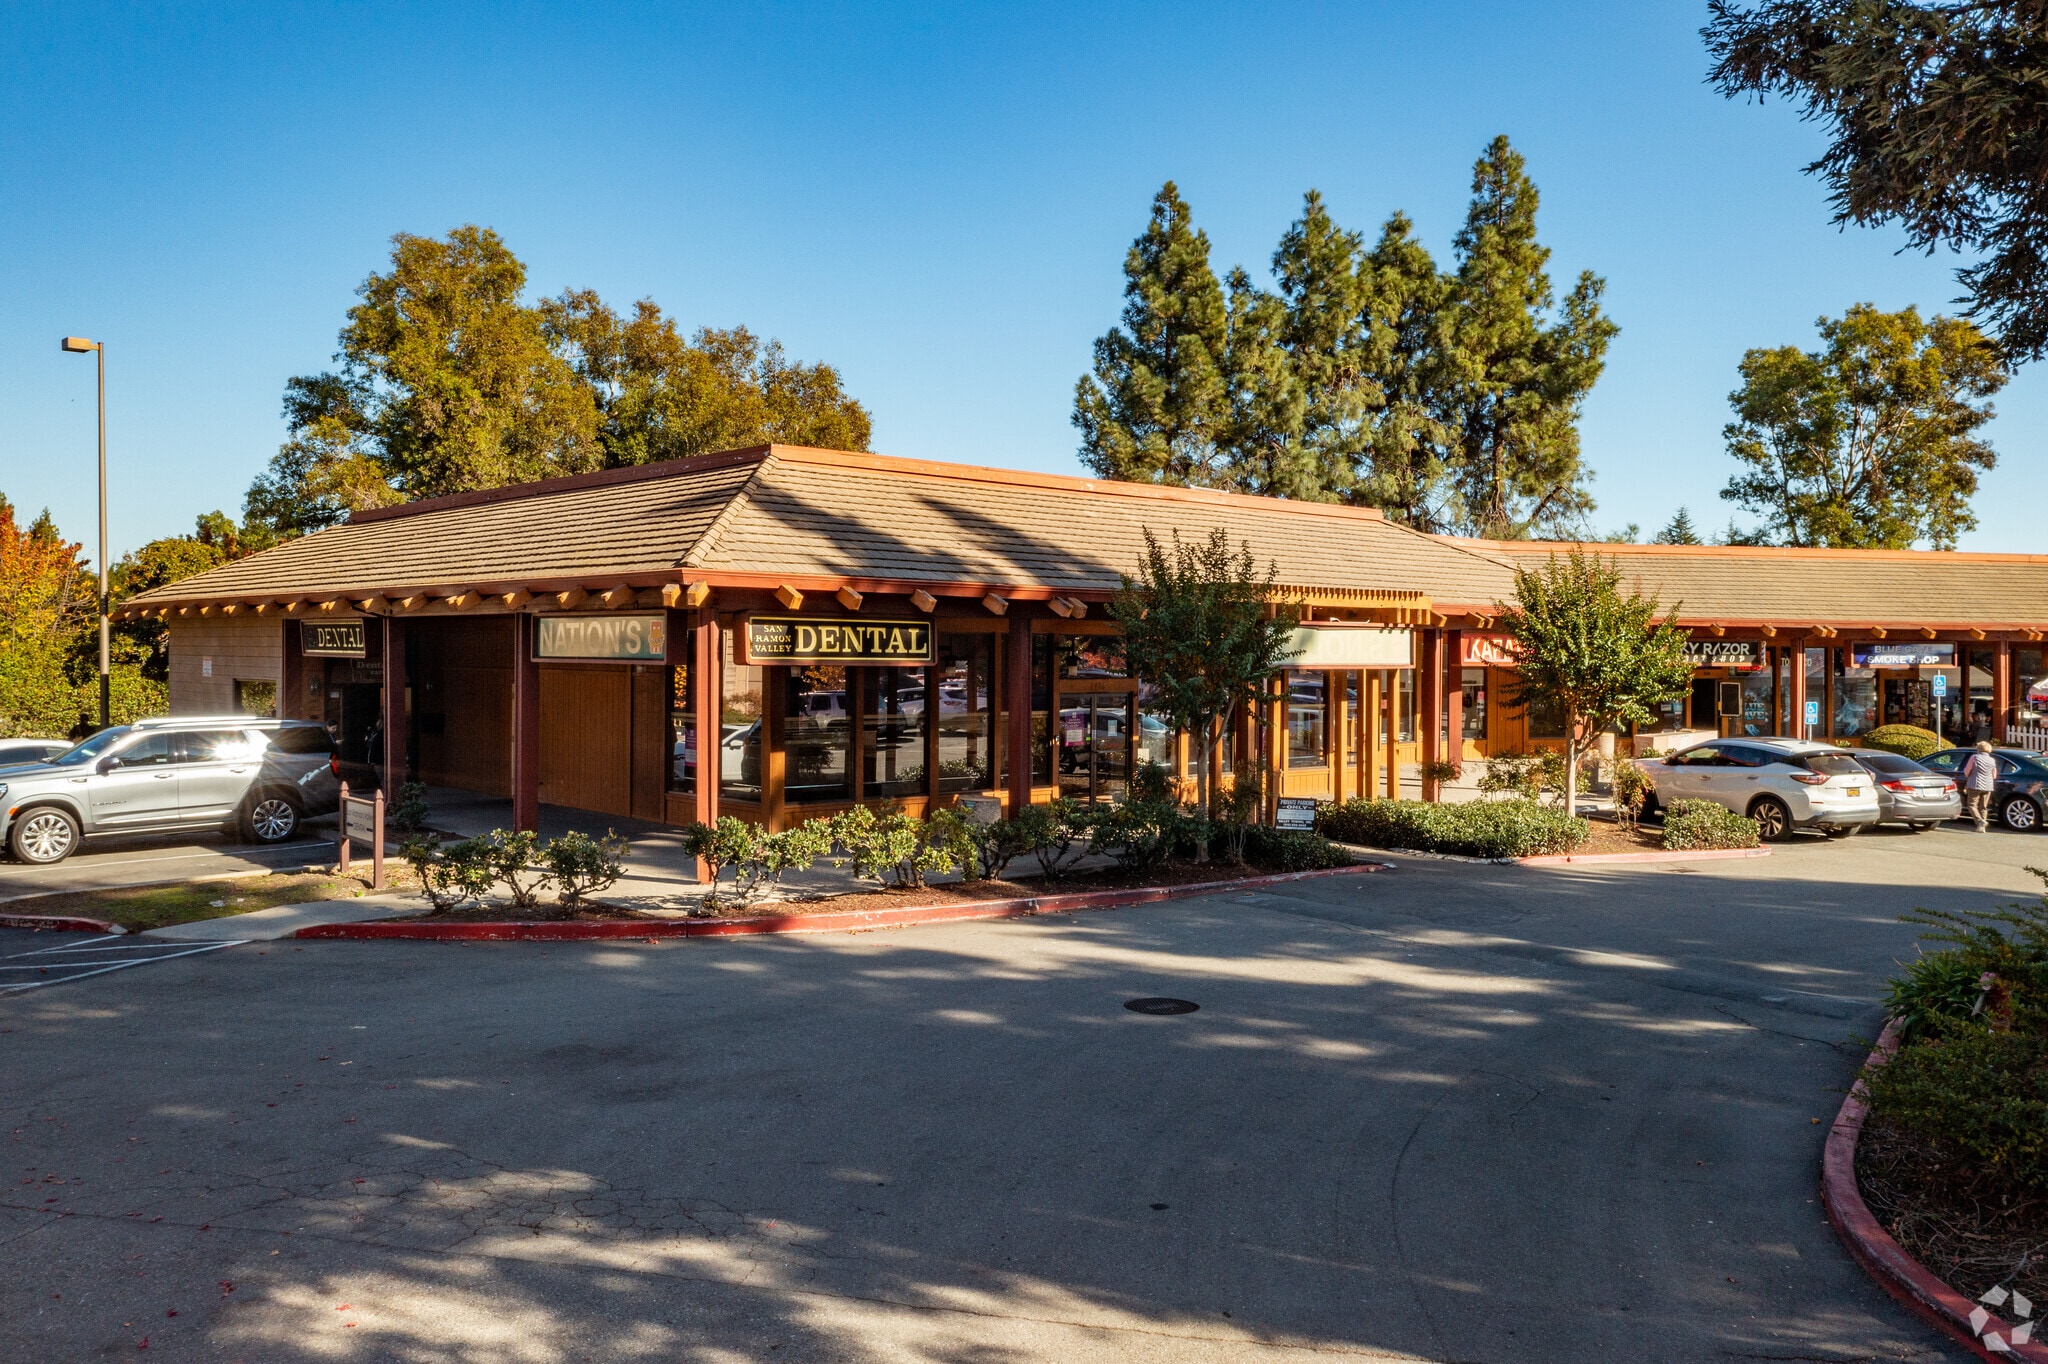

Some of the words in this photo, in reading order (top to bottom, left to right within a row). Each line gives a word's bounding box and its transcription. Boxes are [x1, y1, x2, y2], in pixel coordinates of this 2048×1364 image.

[763, 625, 783, 633] SAN
[317, 628, 364, 648] DENTAL
[539, 620, 642, 654] NATION'S
[756, 634, 792, 643] RAMON
[795, 626, 927, 653] DENTAL
[755, 644, 792, 653] VALLEY
[1703, 642, 1750, 655] RAZOR
[1874, 645, 1901, 653] BLUE
[1867, 655, 1906, 664] SMOKE
